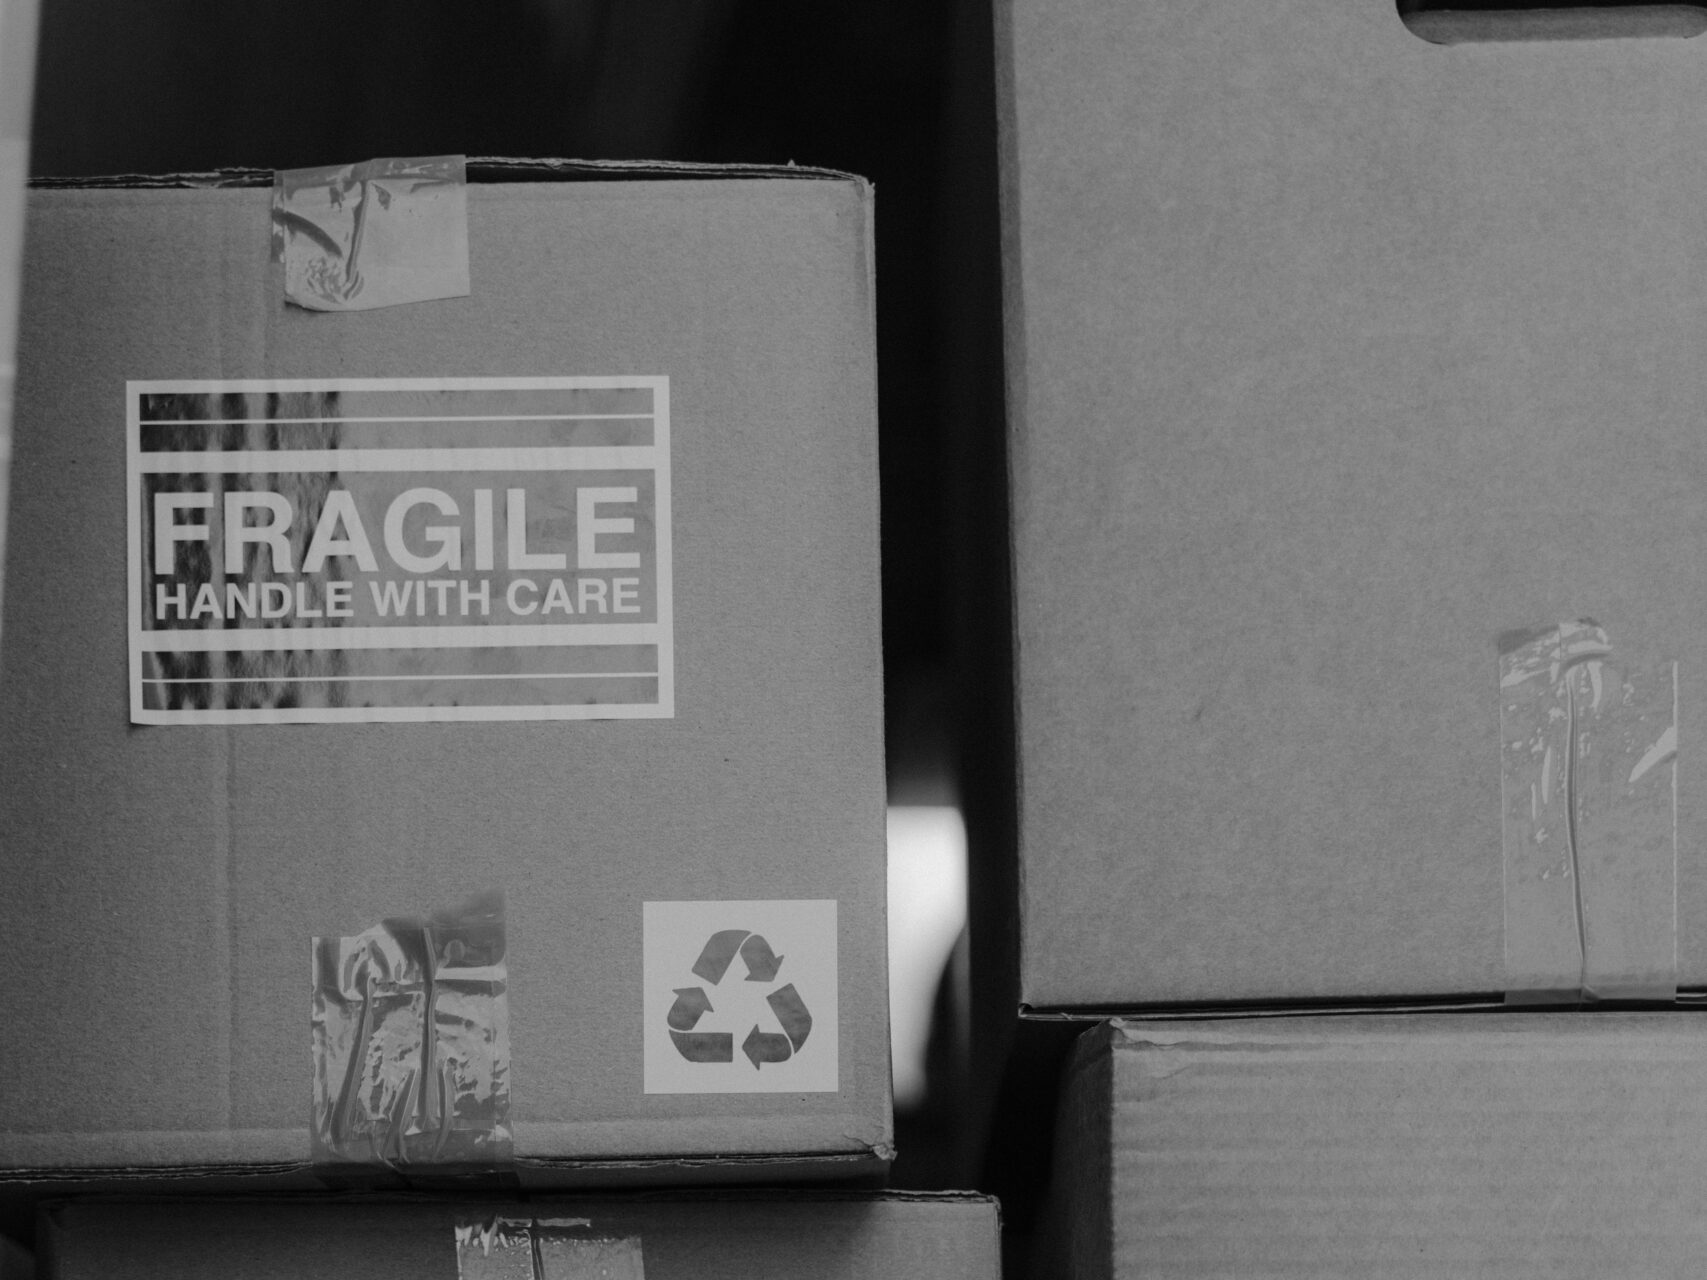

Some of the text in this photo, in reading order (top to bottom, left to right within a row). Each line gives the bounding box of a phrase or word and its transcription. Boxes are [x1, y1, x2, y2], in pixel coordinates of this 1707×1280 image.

[154, 486, 640, 575] FRAGILE
[156, 577, 641, 620] HANDLE WITH CARE
